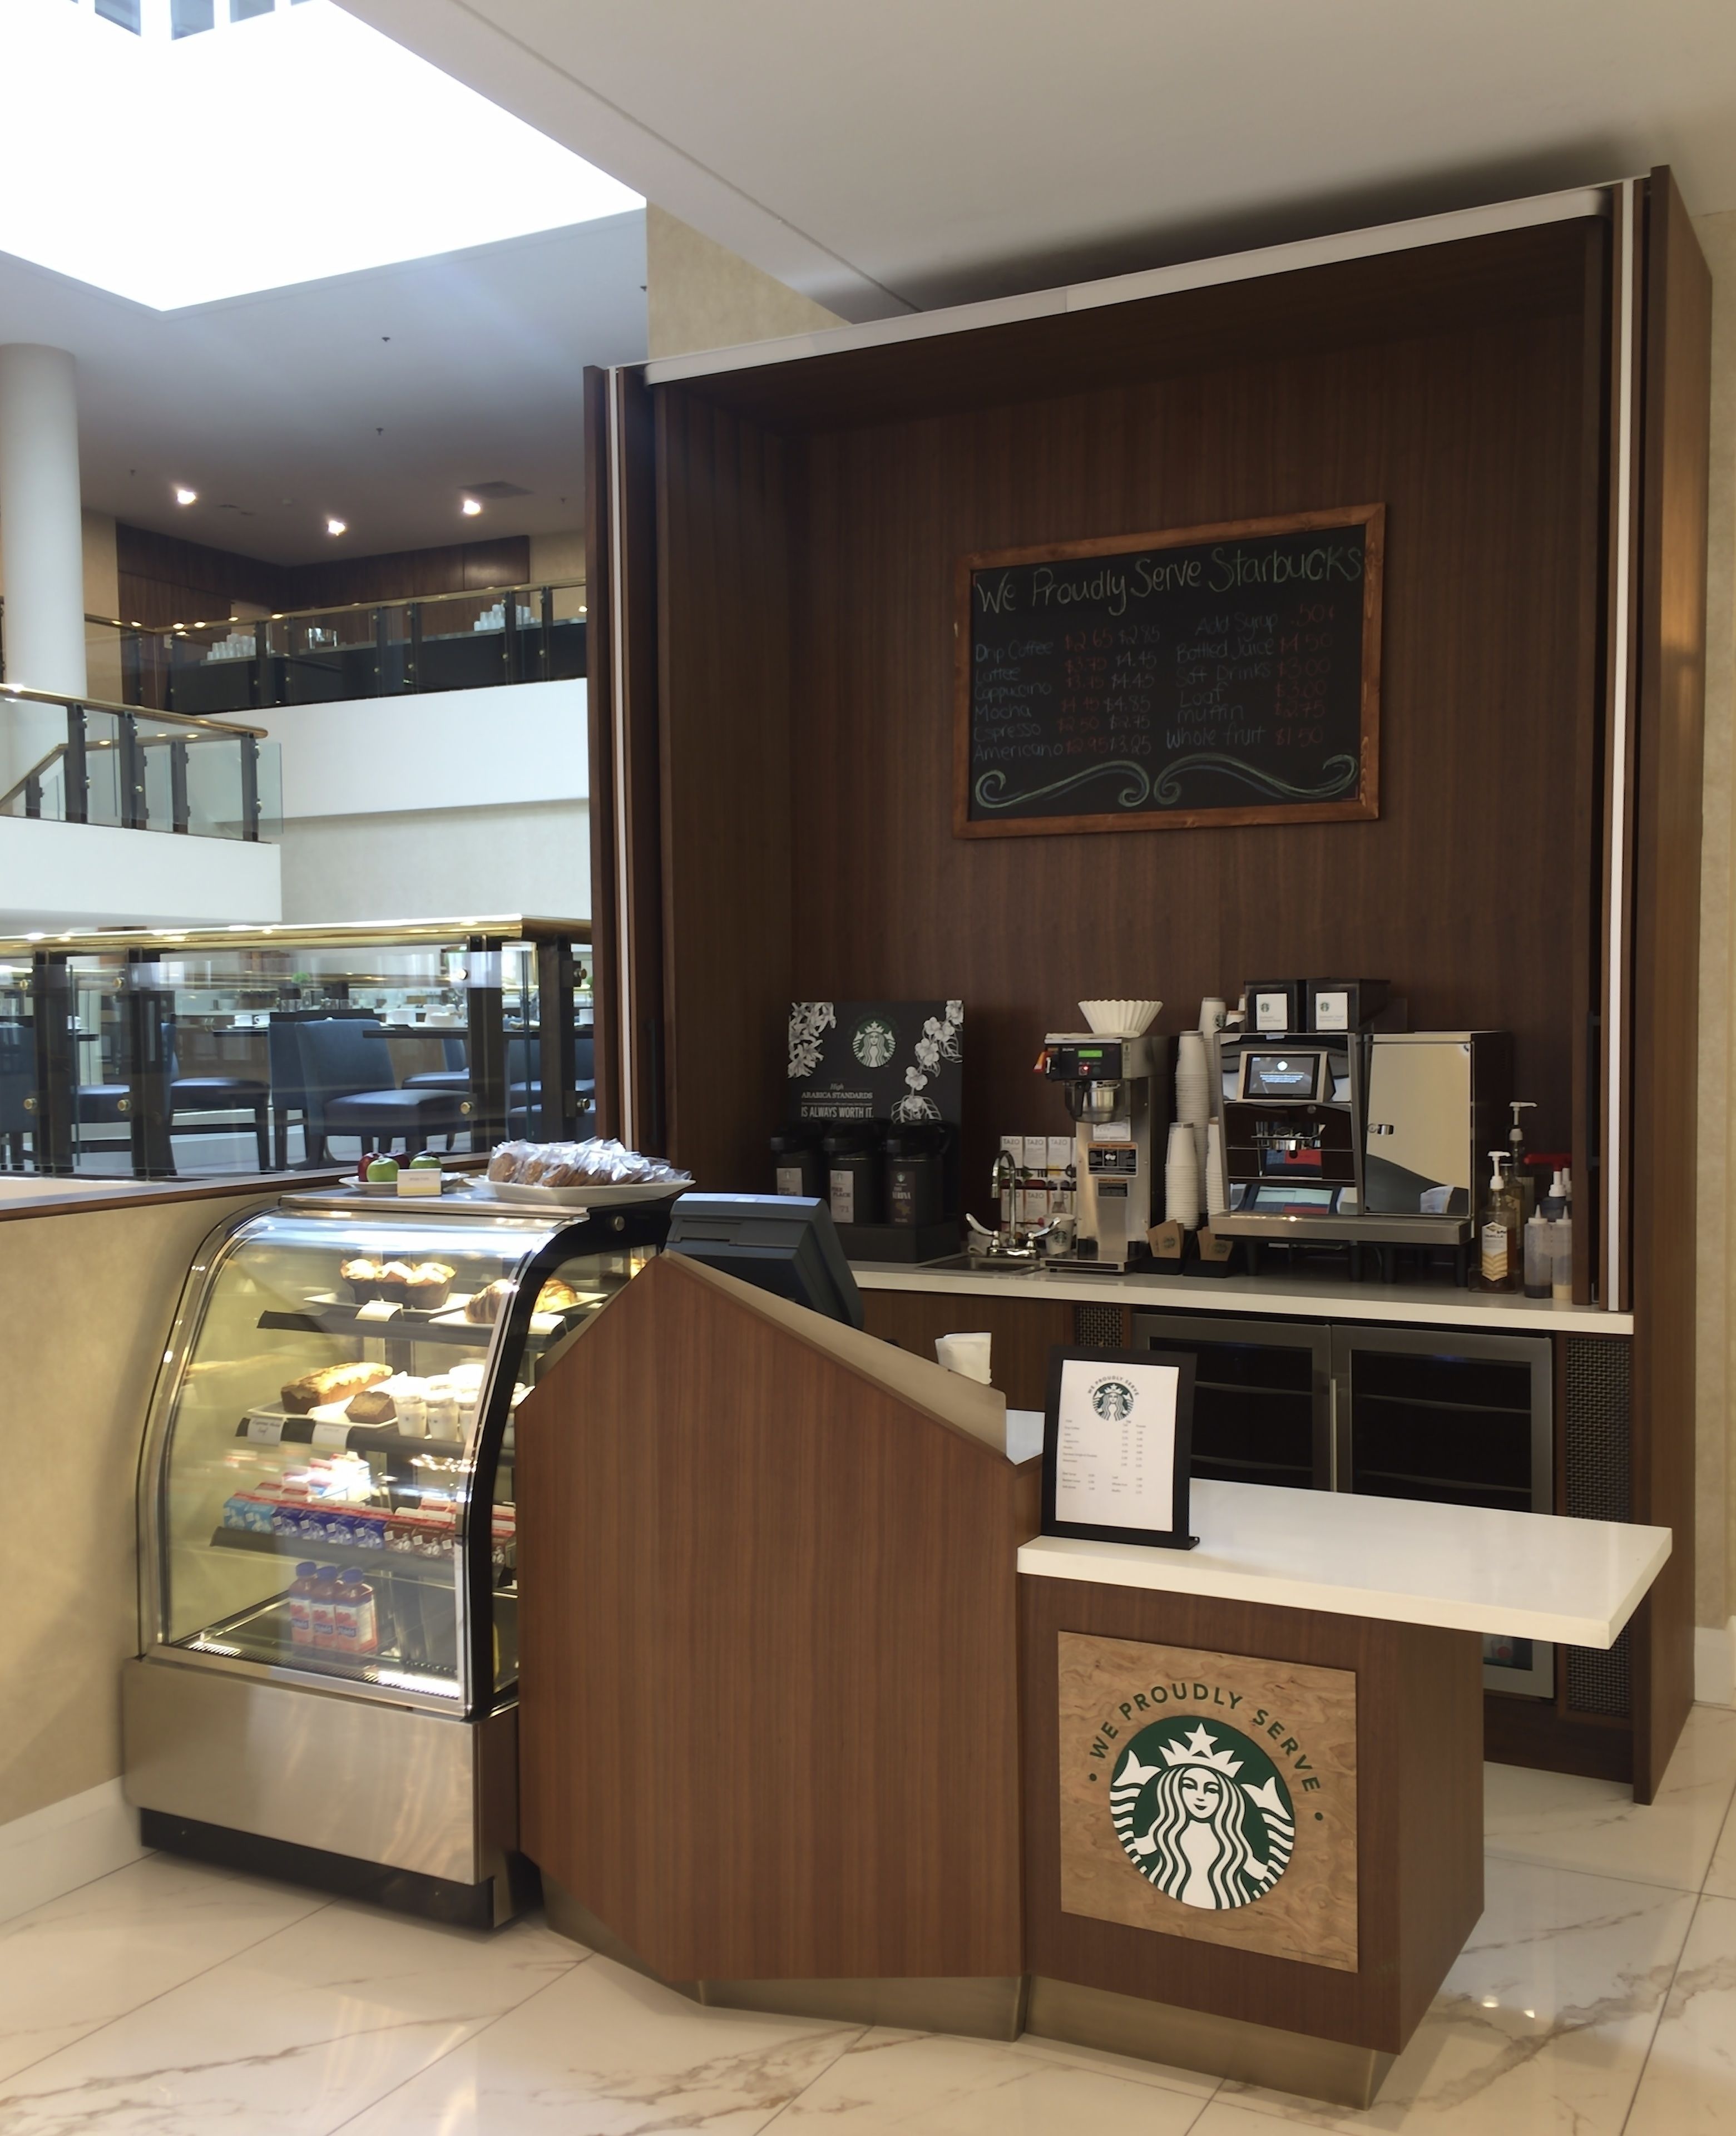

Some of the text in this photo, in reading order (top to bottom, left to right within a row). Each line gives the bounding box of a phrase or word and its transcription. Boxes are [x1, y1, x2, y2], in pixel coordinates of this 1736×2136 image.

[977, 572, 1016, 614] We
[1032, 567, 1127, 616] Proudly
[1130, 557, 1201, 597] Serve
[1195, 615, 1229, 636] Add
[1233, 612, 1278, 642] Syrup
[975, 644, 1005, 664] Drip
[1008, 640, 1054, 660] Coffee
[1176, 640, 1228, 664] Bottled
[1230, 637, 1275, 660] Juice
[1175, 665, 1208, 688] Soft
[1216, 661, 1271, 681] Drinks
[1180, 681, 1229, 708] Loaf
[975, 703, 1032, 722] Mocha
[974, 723, 1042, 743] Espresso
[1166, 726, 1216, 750] Whole
[1223, 721, 1267, 746] fruit
[973, 743, 1064, 762] Americano
[801, 1106, 809, 1118] IS
[809, 1106, 837, 1118] ALWAYS
[838, 1106, 864, 1118] WORTH
[1095, 1375, 1123, 1385] PROUDLY
[1090, 1682, 1321, 1793] WE PROUDLY SERVE
